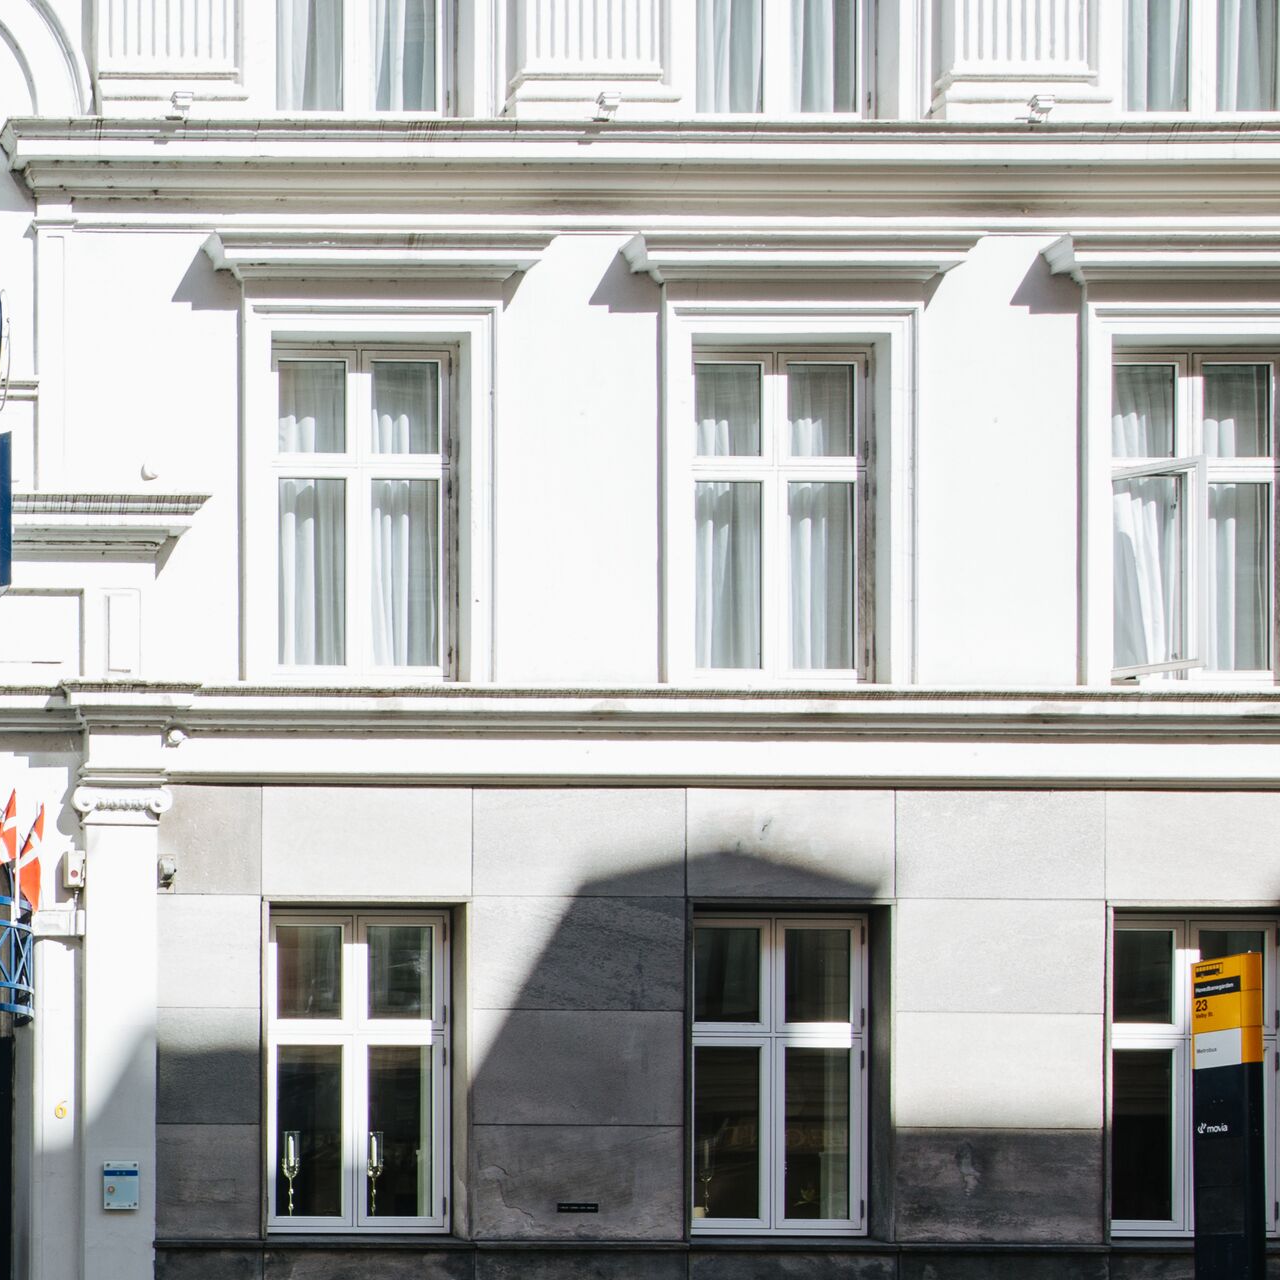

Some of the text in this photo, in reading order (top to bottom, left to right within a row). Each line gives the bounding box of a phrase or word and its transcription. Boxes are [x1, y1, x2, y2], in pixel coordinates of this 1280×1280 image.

[1195, 999, 1208, 1012] 23
[54, 1099, 68, 1120] 6
[1207, 1123, 1228, 1133] movia
